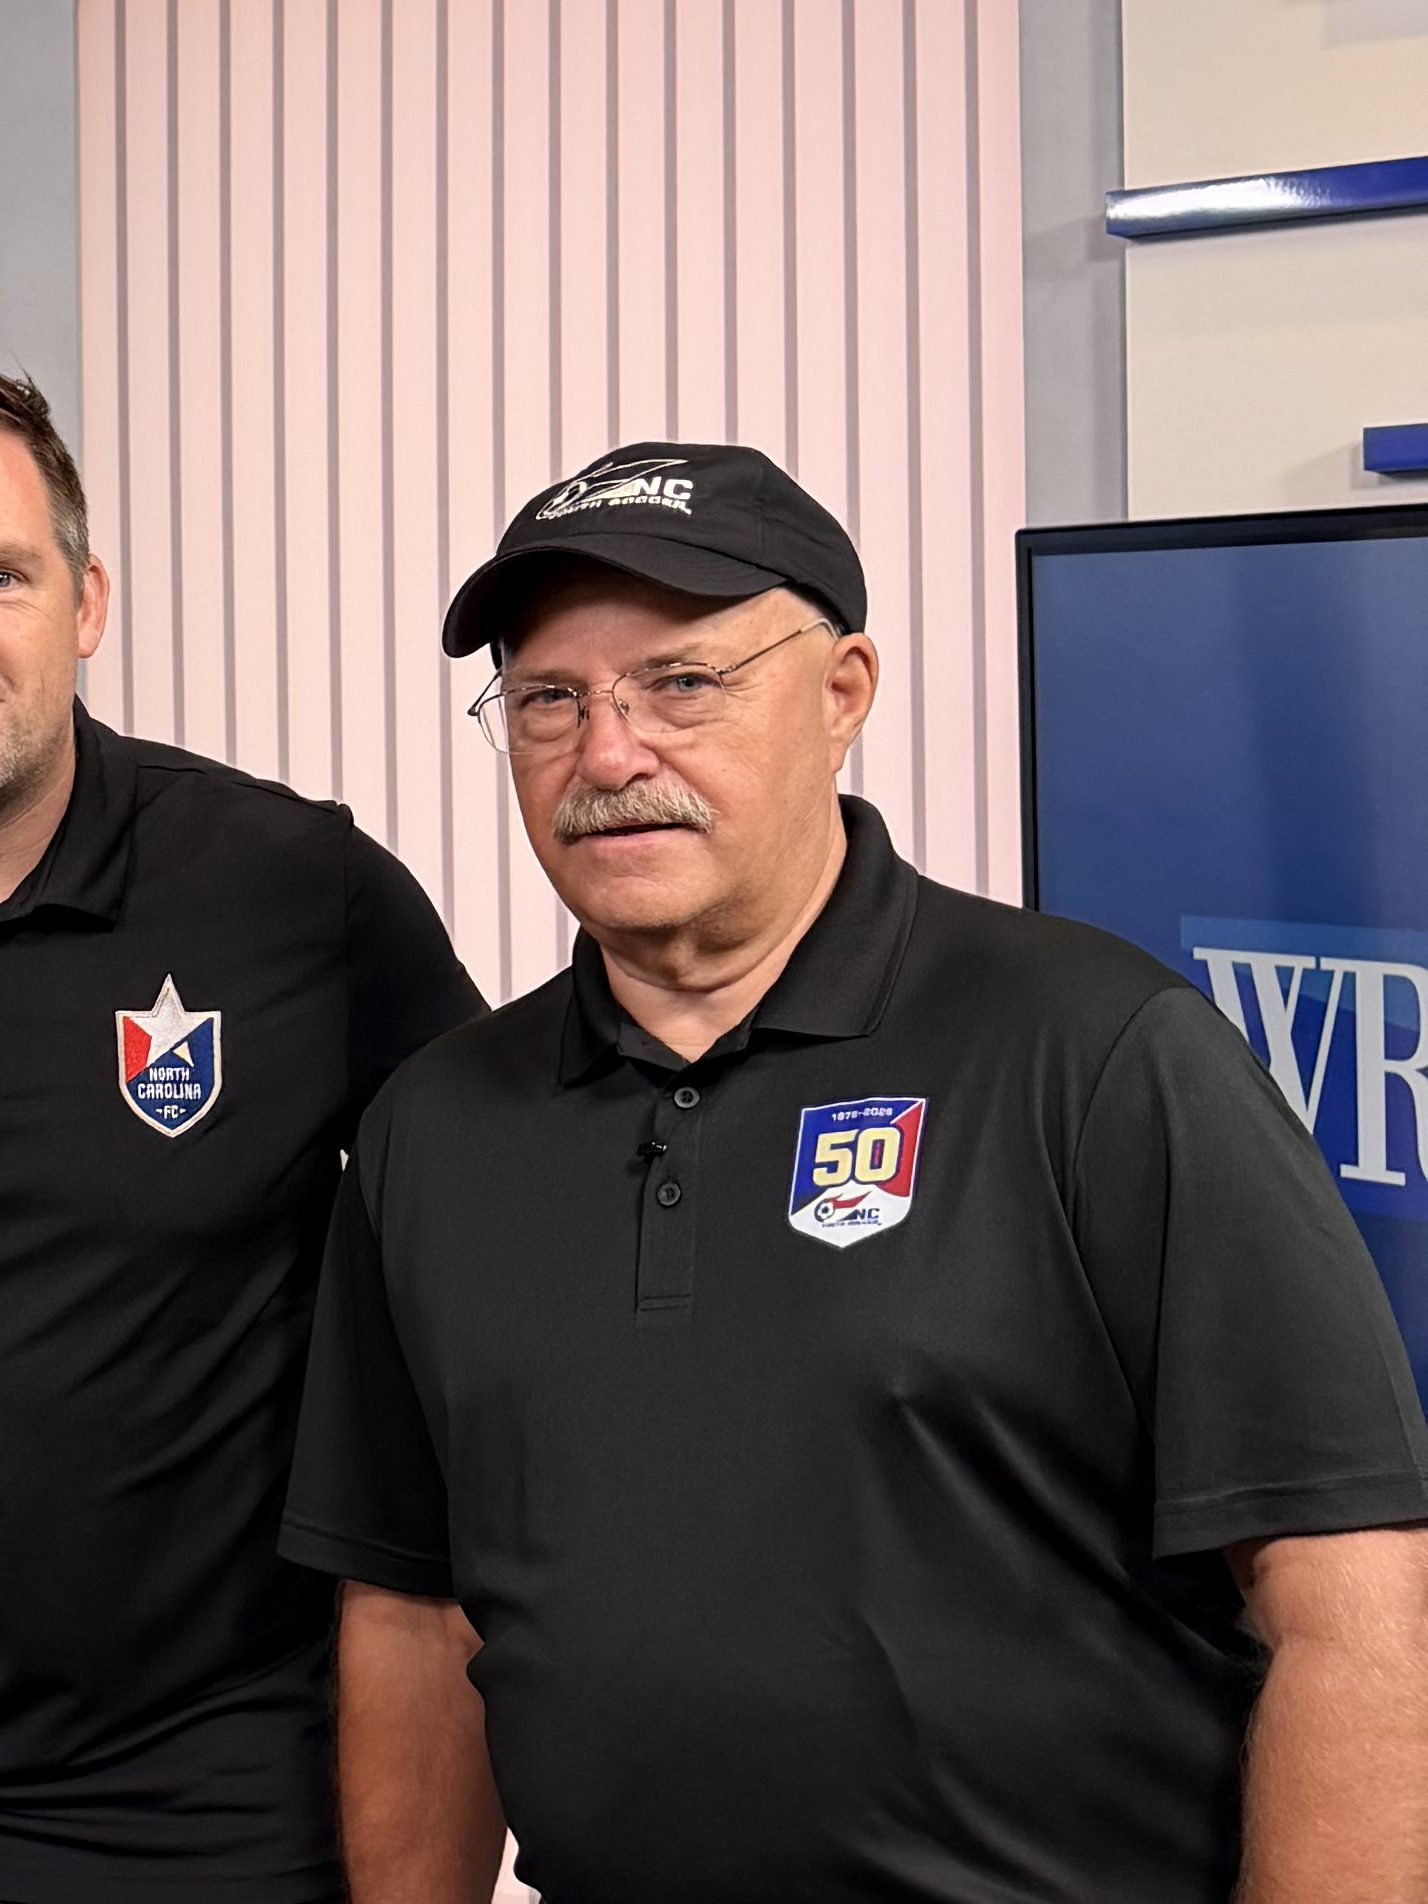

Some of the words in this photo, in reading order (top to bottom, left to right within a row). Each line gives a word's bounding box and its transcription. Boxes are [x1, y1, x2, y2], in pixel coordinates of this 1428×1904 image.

[149, 1066, 190, 1082] NORTH
[137, 1082, 202, 1100] CAROLINA
[812, 1126, 901, 1187] 50
